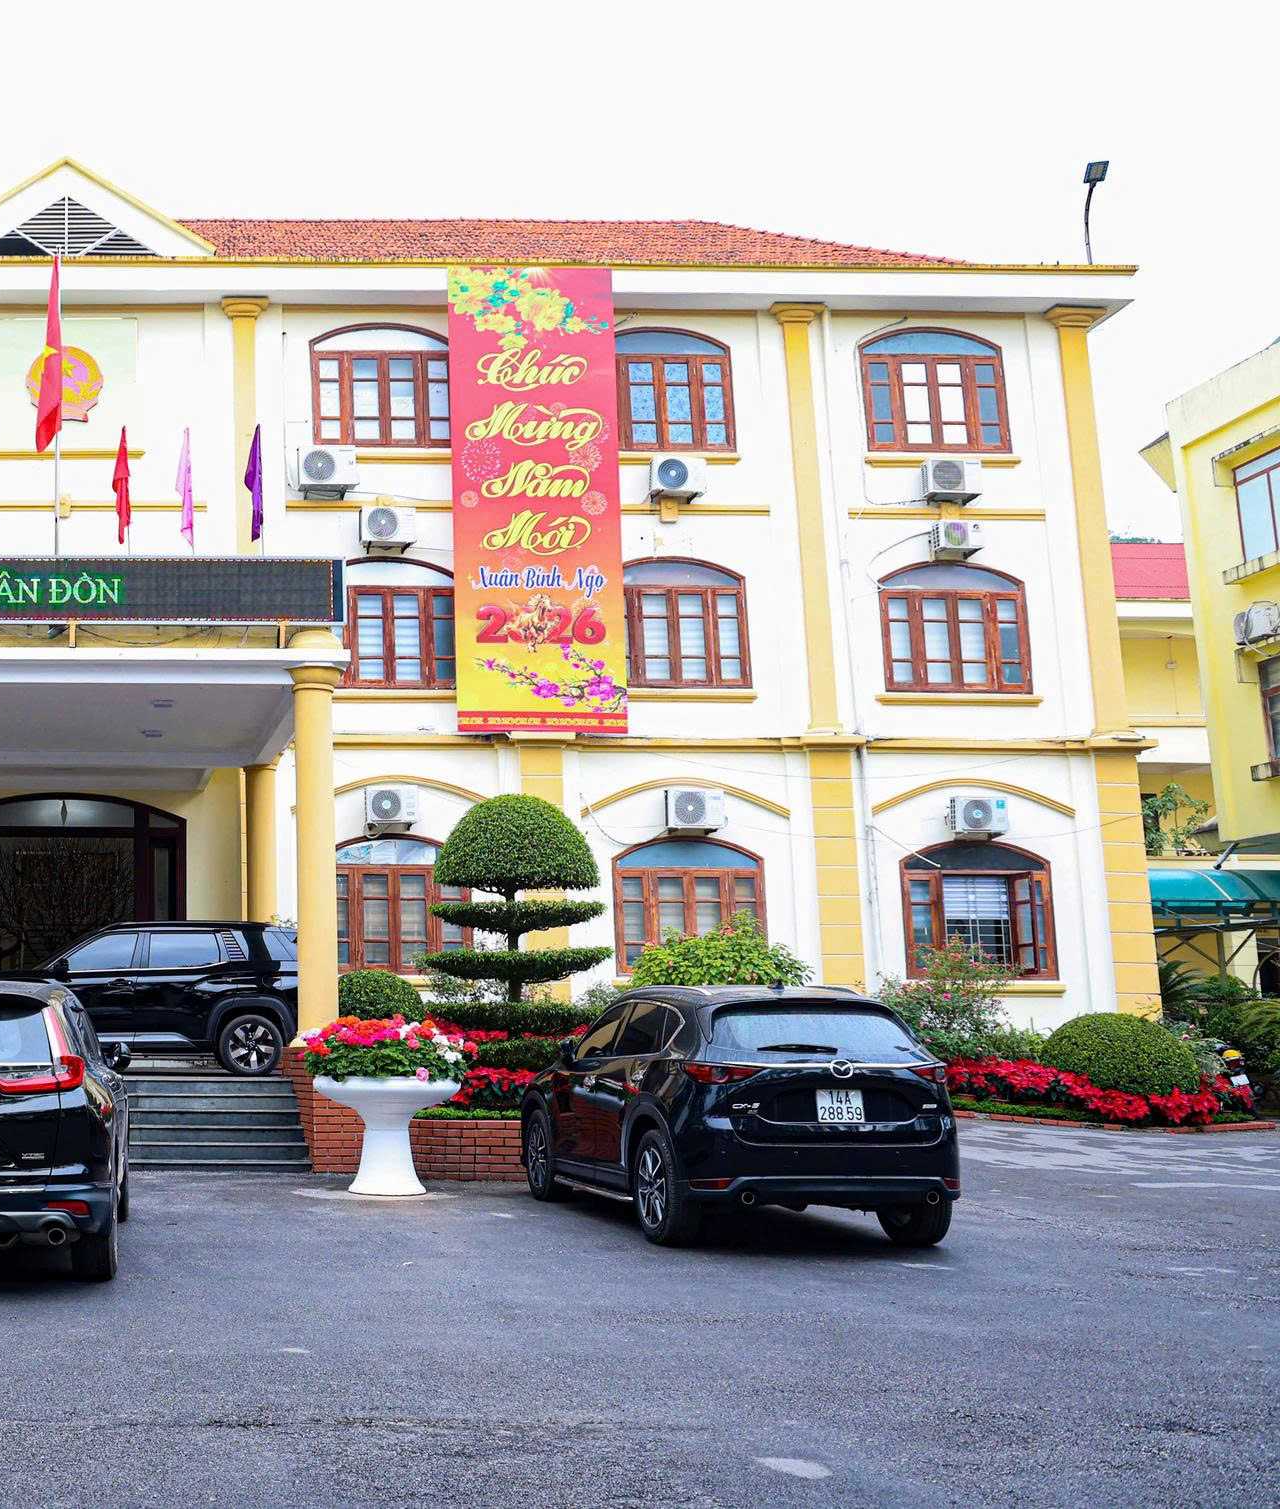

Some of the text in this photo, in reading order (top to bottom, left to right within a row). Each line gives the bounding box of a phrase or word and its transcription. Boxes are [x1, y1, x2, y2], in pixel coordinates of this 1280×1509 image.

[476, 347, 589, 392] Chúc
[465, 400, 603, 451] Mừng
[48, 571, 122, 604] ĐỒN
[473, 566, 519, 589] Xuân
[828, 1090, 852, 1106] 14A
[820, 1106, 863, 1121] 288.59
